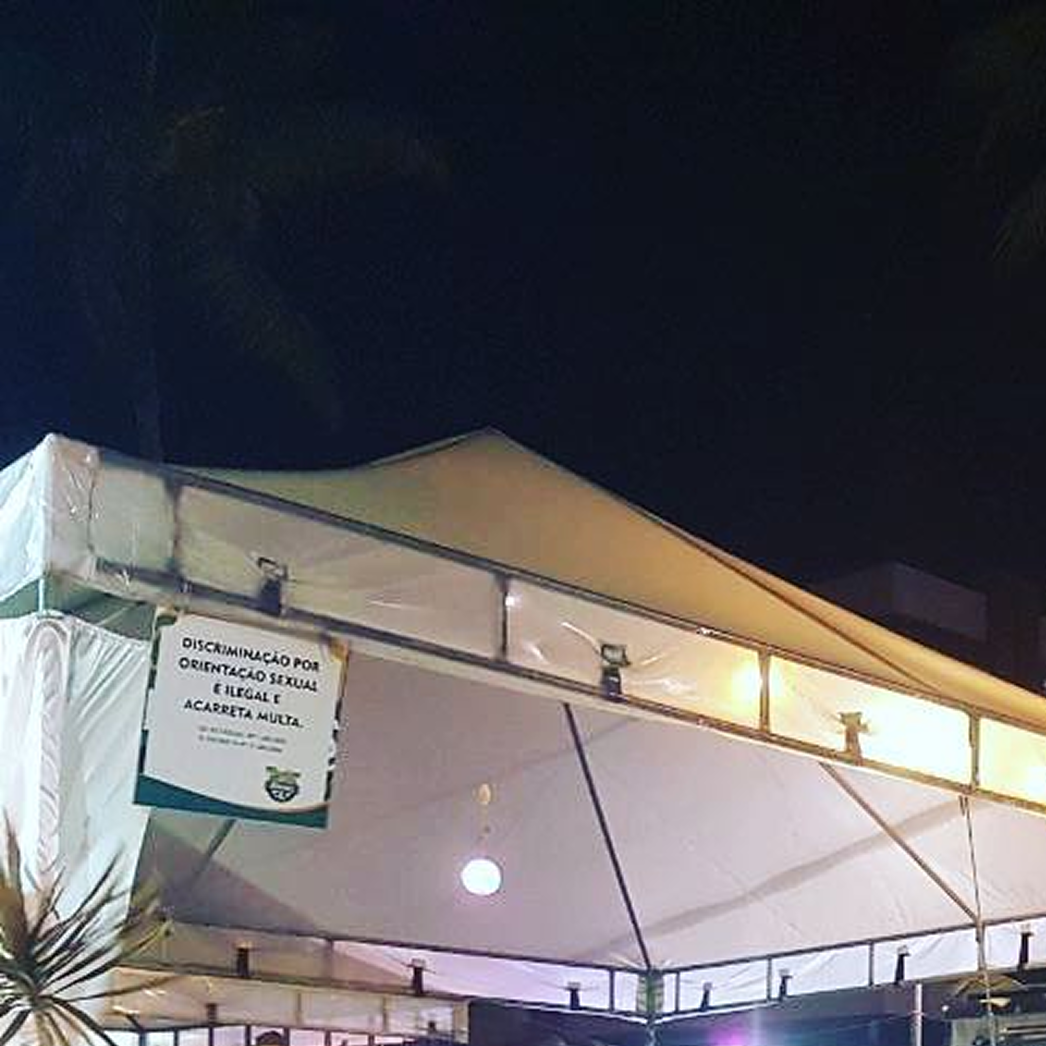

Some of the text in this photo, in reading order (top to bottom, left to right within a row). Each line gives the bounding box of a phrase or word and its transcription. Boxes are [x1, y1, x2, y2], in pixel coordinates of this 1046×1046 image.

[182, 637, 319, 673] DISCRIMINAÇÃO POR
[269, 672, 317, 692] SEXUAL
[225, 684, 269, 703] ILEGAL
[184, 699, 253, 720] ACARRETA
